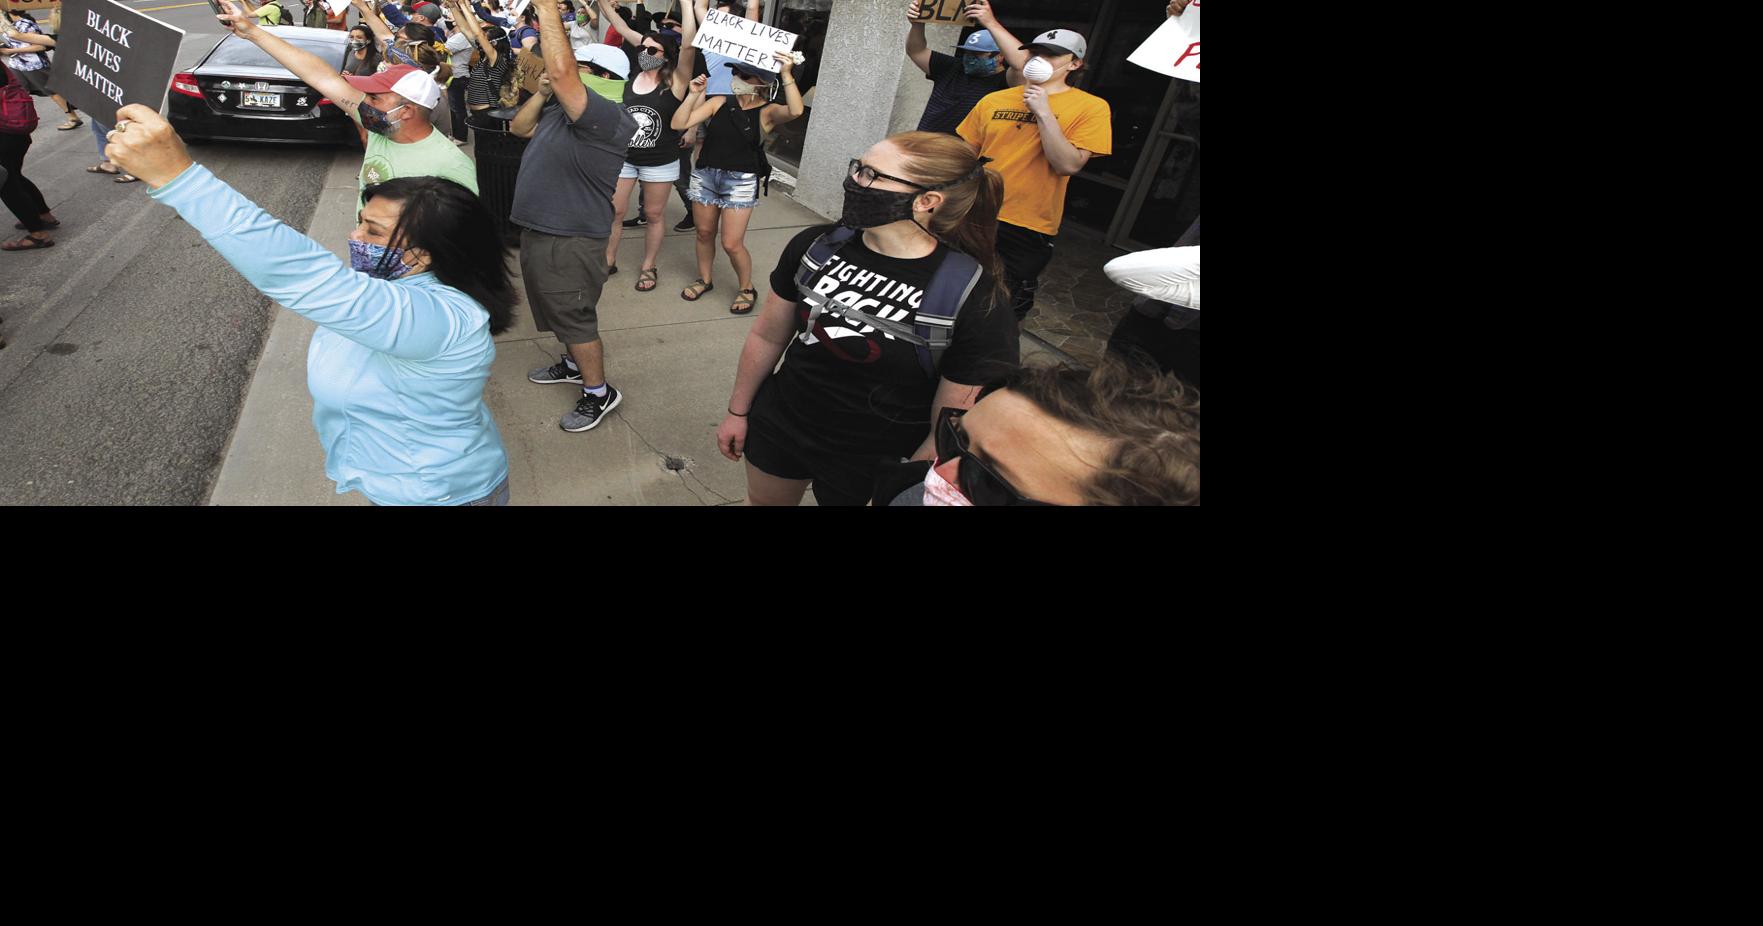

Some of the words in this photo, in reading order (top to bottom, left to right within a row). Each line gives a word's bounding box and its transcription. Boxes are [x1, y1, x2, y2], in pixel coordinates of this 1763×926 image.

[86, 9, 133, 49] BLACK
[706, 8, 744, 30] BLACK
[750, 23, 790, 45] LIVES
[968, 33, 981, 44] 3
[85, 38, 122, 73] LIVES
[73, 60, 124, 106] MATTER
[994, 111, 1029, 121] STRIPE
[820, 255, 924, 309] FIGHTING
[802, 274, 910, 340] BACK
